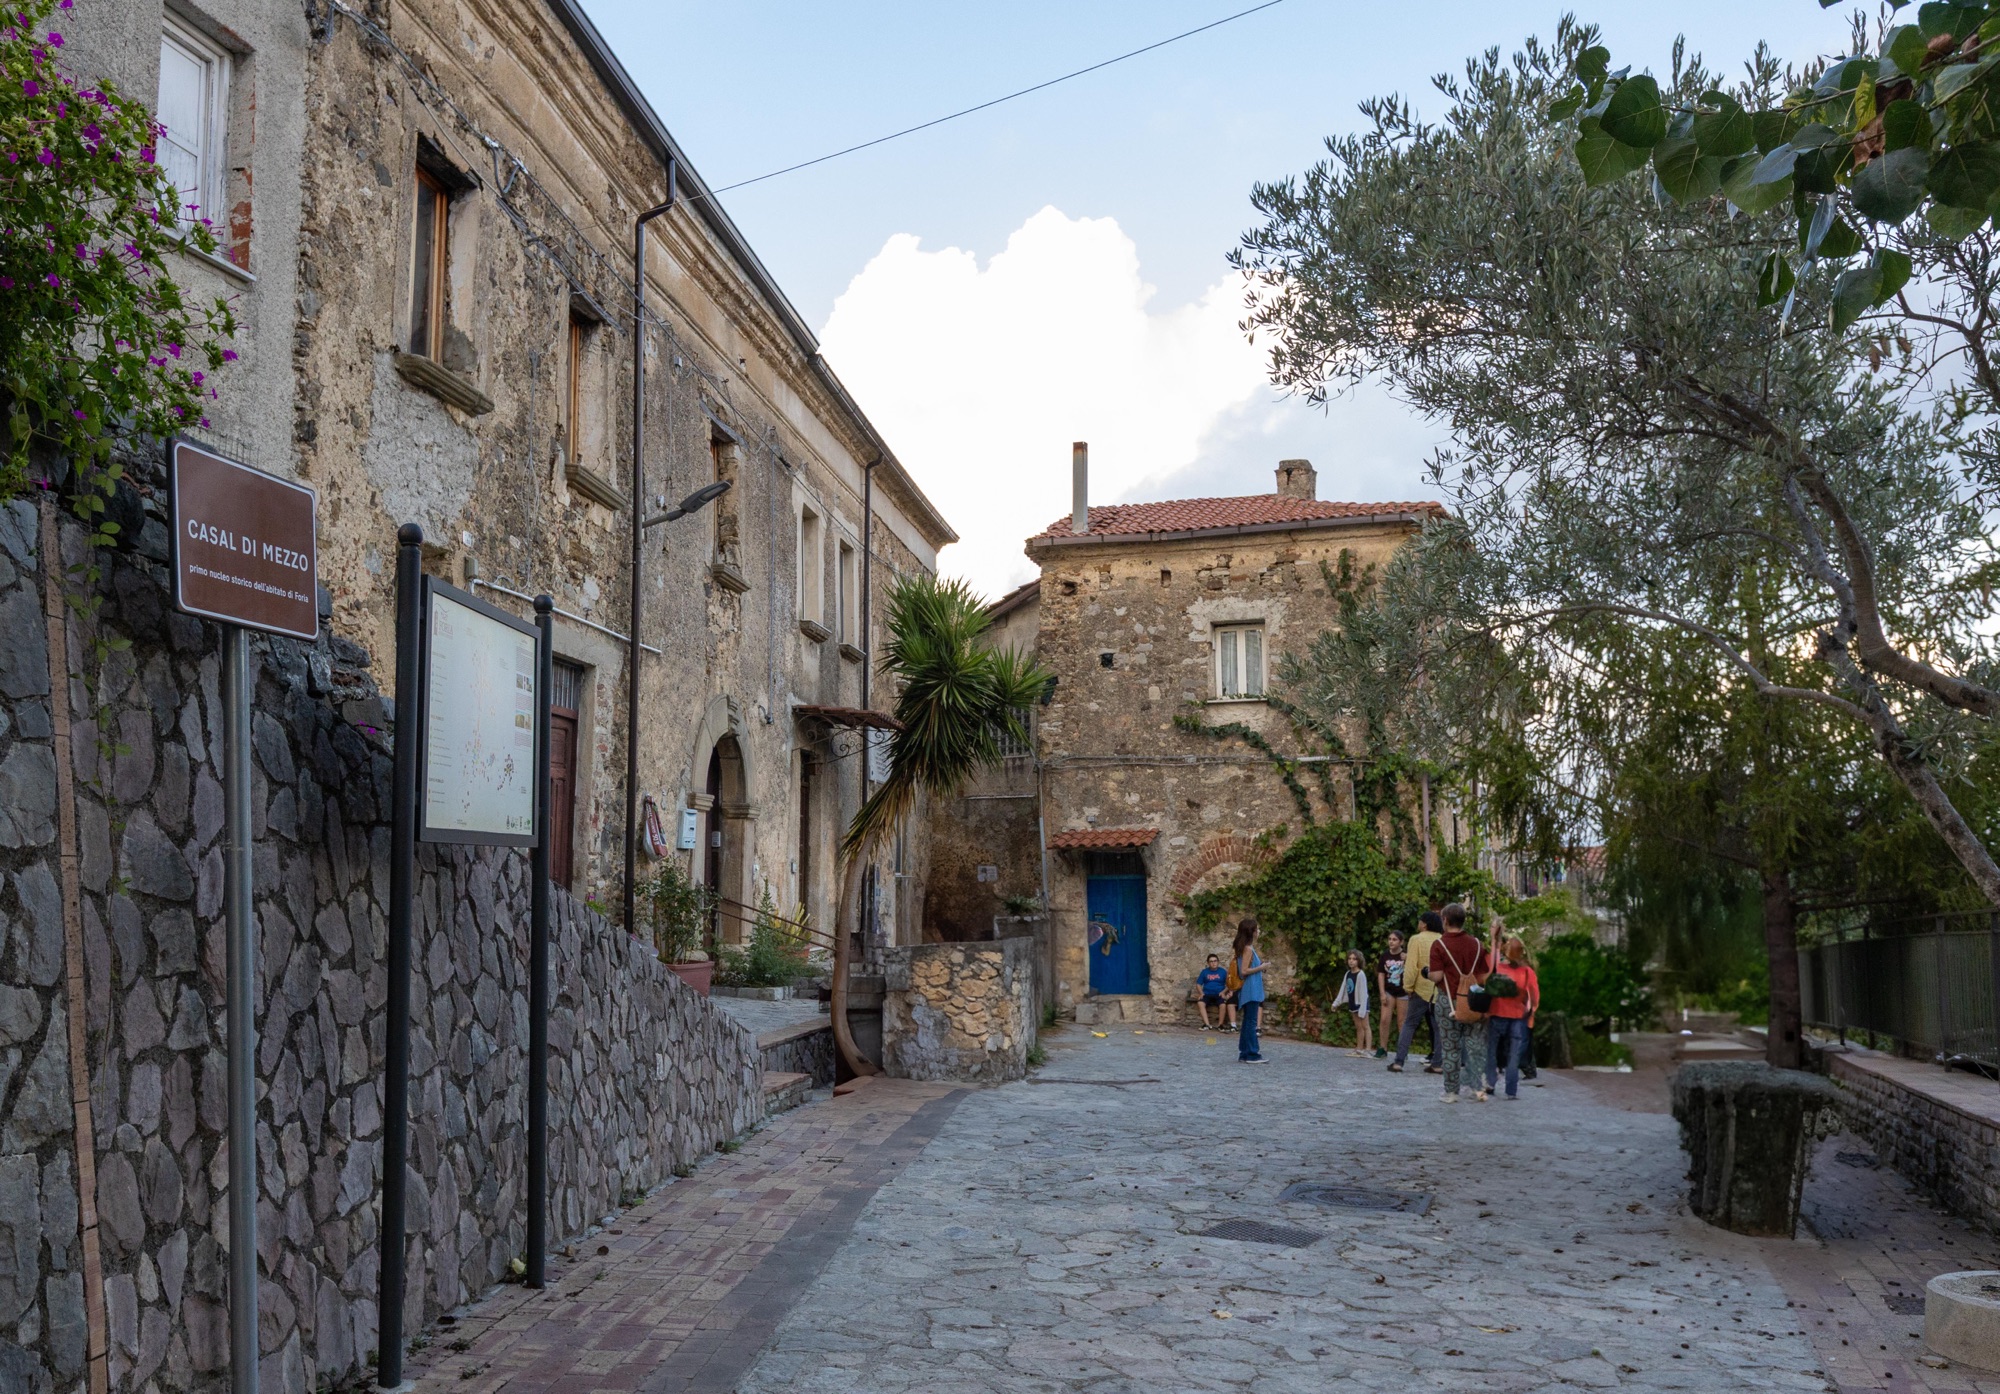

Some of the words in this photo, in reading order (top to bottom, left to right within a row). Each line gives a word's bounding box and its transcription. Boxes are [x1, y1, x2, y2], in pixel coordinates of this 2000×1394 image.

[188, 519, 237, 551] CASAL
[242, 536, 257, 557] DI
[262, 542, 309, 572] MEZZO
[189, 564, 208, 576] primo
[209, 570, 230, 582] nucleo
[231, 575, 252, 588] storico
[253, 581, 287, 597] dell'abitato
[287, 590, 294, 599] di
[294, 591, 309, 603] Foria
